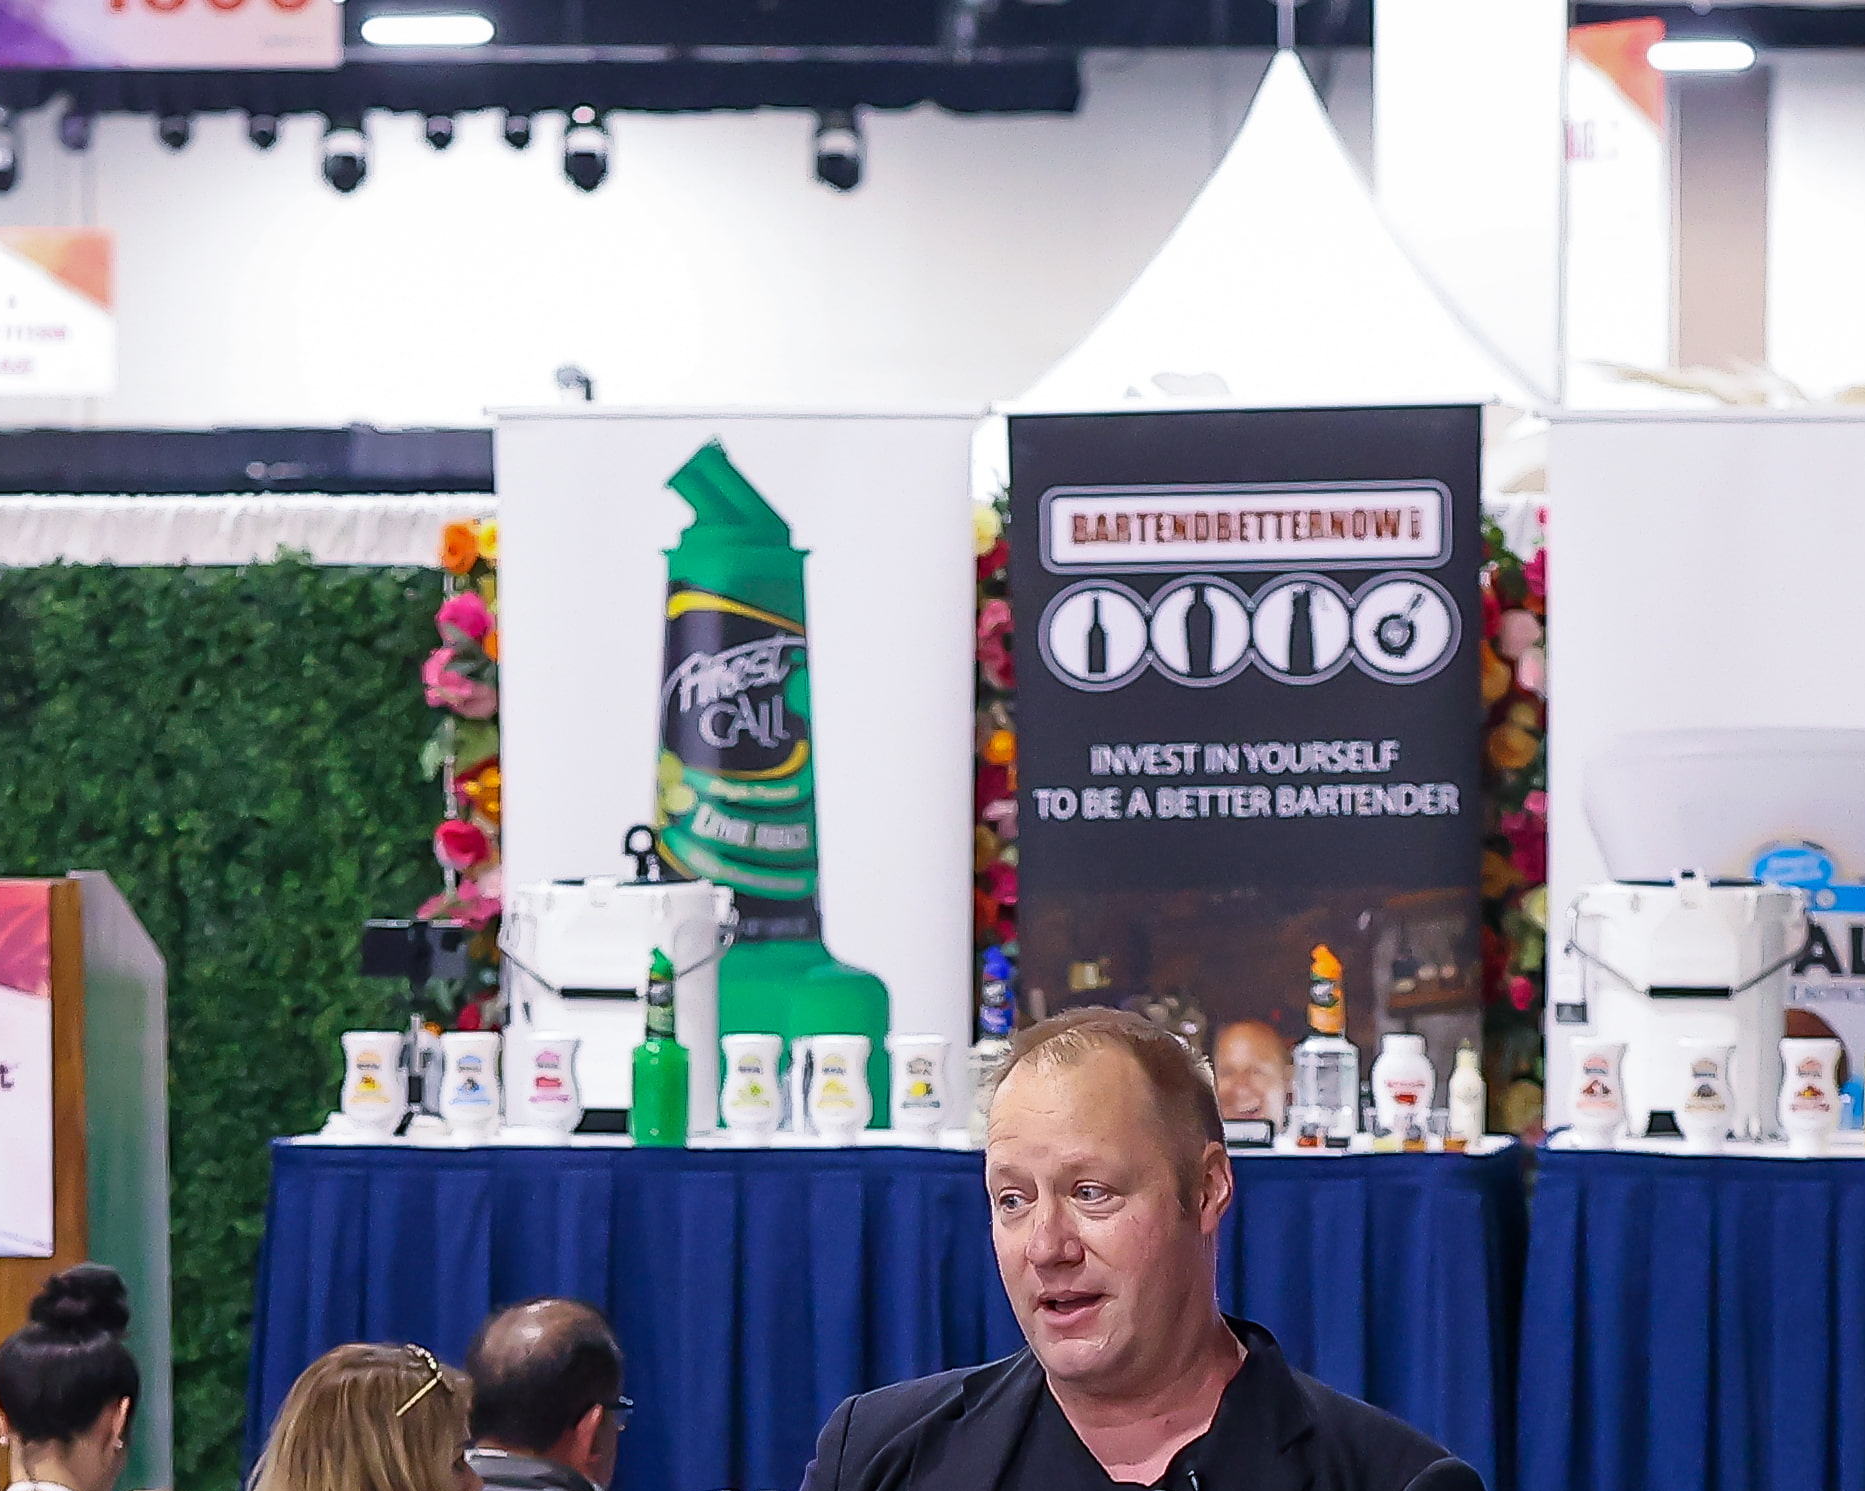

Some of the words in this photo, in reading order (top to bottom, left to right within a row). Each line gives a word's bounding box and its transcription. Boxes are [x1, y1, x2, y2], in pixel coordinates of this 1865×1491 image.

[1089, 742, 1203, 777] INVEST
[1203, 743, 1240, 776] IN
[1241, 739, 1401, 774] YOURSELF
[1032, 787, 1078, 821] TO
[1081, 786, 1123, 820] BE
[1124, 786, 1154, 820] A
[1155, 784, 1272, 820] BETTER
[1274, 781, 1461, 818] BARTENDER
